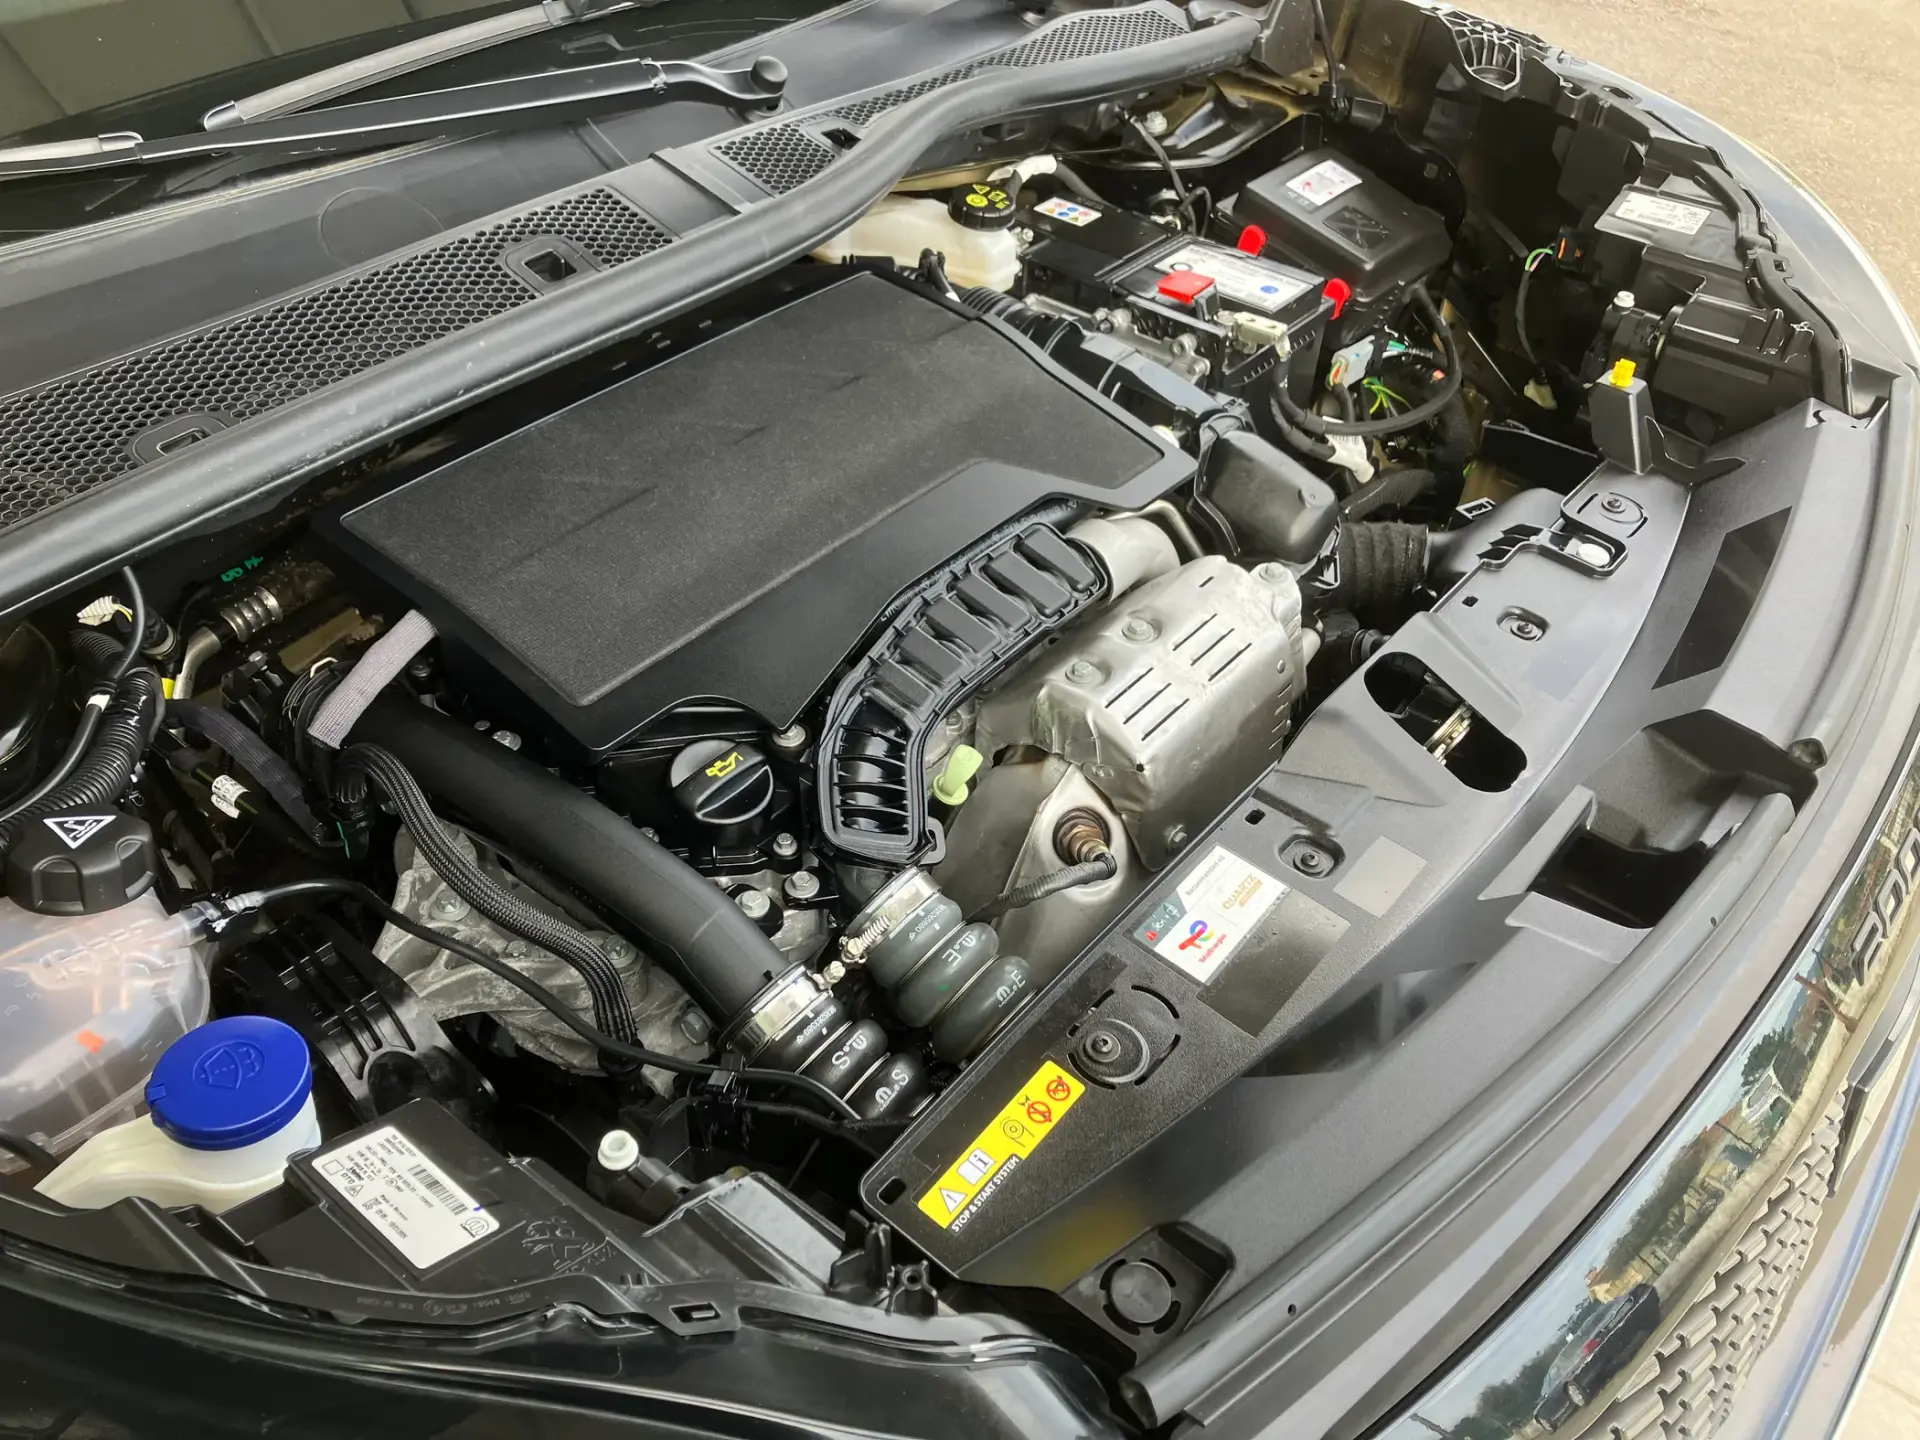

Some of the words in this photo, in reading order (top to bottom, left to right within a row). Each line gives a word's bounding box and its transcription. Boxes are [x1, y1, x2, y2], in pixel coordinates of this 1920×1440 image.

[1222, 873, 1258, 910] QUARTZ
[1852, 808, 1920, 986] 200
[1198, 933, 1227, 963] TotalEnergies
[951, 1211, 972, 1232] STOP
[968, 1204, 977, 1213] &
[974, 1182, 996, 1206] START
[993, 1156, 1020, 1184] SYSTEM
